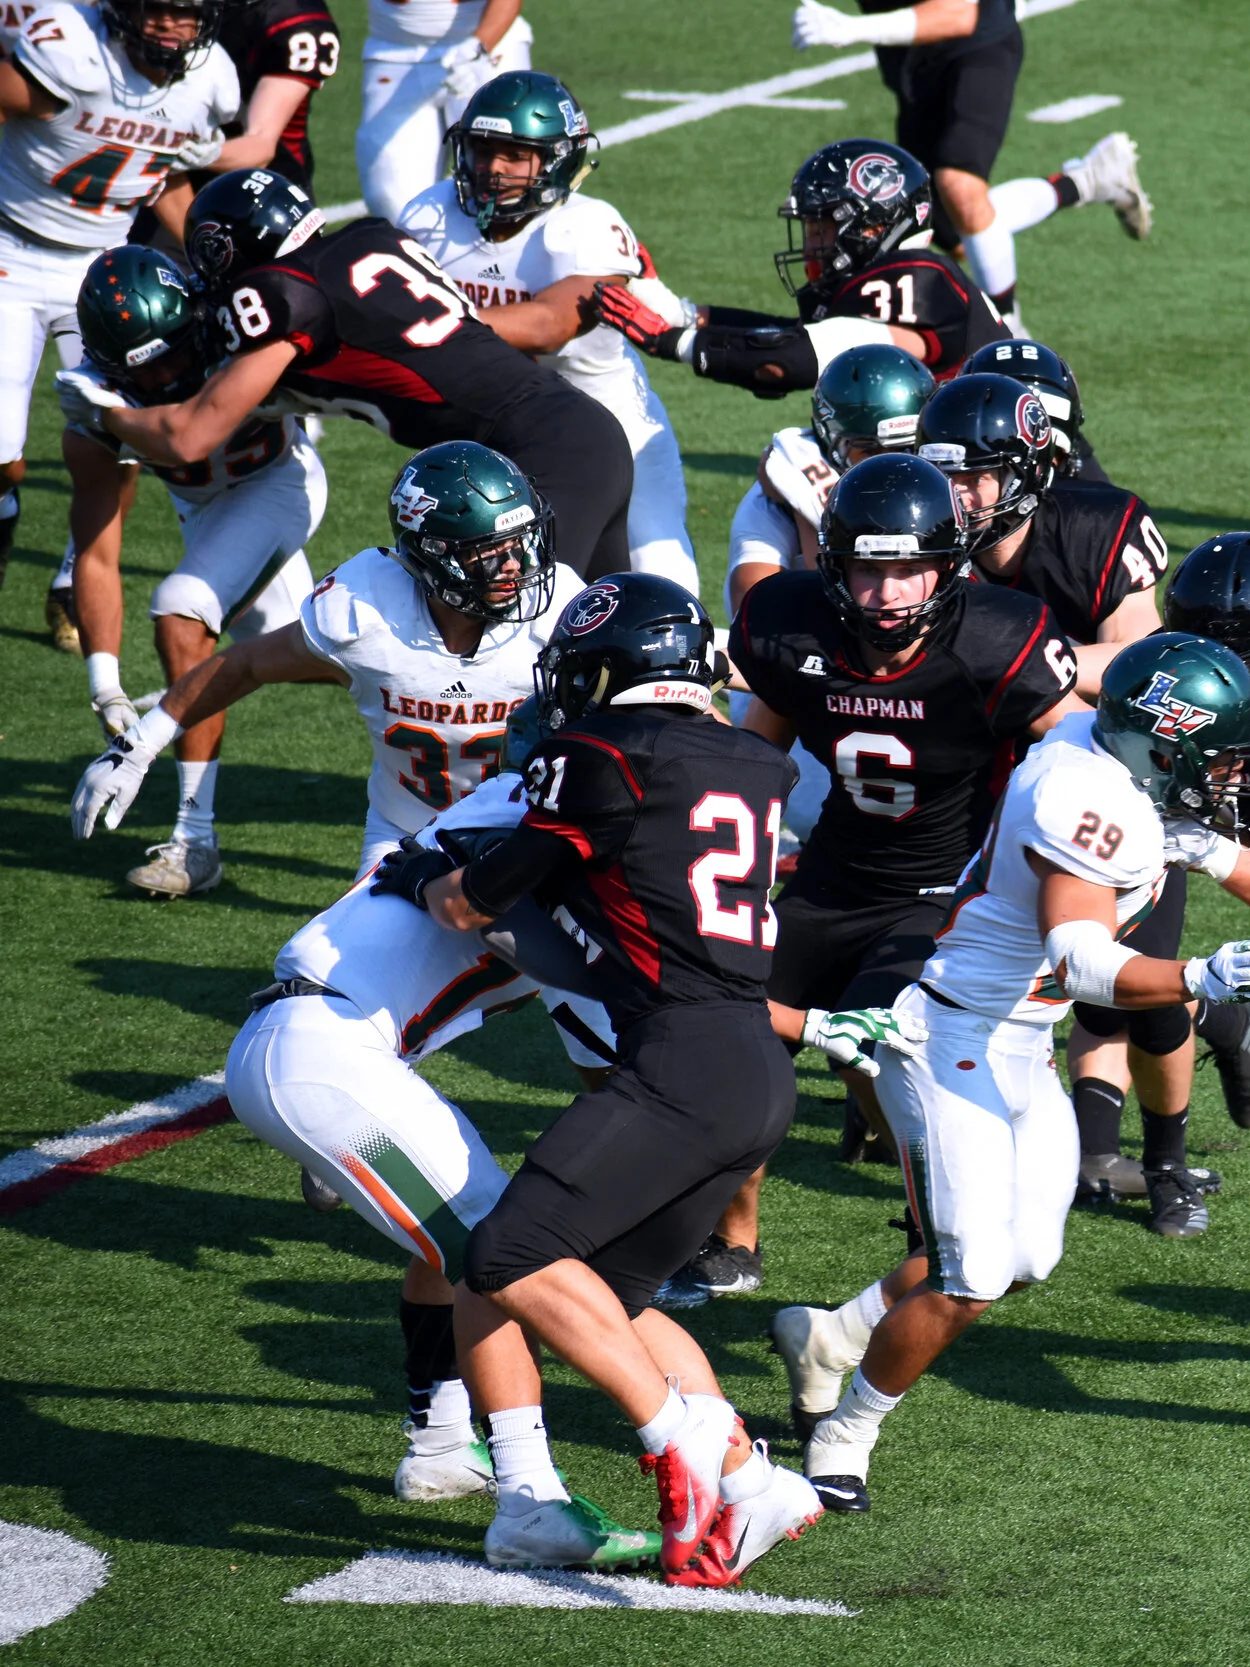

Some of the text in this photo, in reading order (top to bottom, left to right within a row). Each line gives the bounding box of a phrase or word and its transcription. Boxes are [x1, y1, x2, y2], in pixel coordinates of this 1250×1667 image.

[288, 31, 340, 76] 83
[241, 170, 274, 195] 38
[477, 273, 506, 281] adidas
[861, 273, 918, 324] 31
[216, 286, 272, 352] 38
[995, 345, 1039, 360] 22
[1121, 513, 1168, 591] 40
[1043, 638, 1077, 691] 6
[439, 691, 473, 699] adidas
[825, 694, 925, 720] CHAPMAN
[527, 755, 568, 813] 21
[832, 729, 917, 822] 6
[1071, 810, 1125, 861] 29
[688, 790, 782, 952] 21
